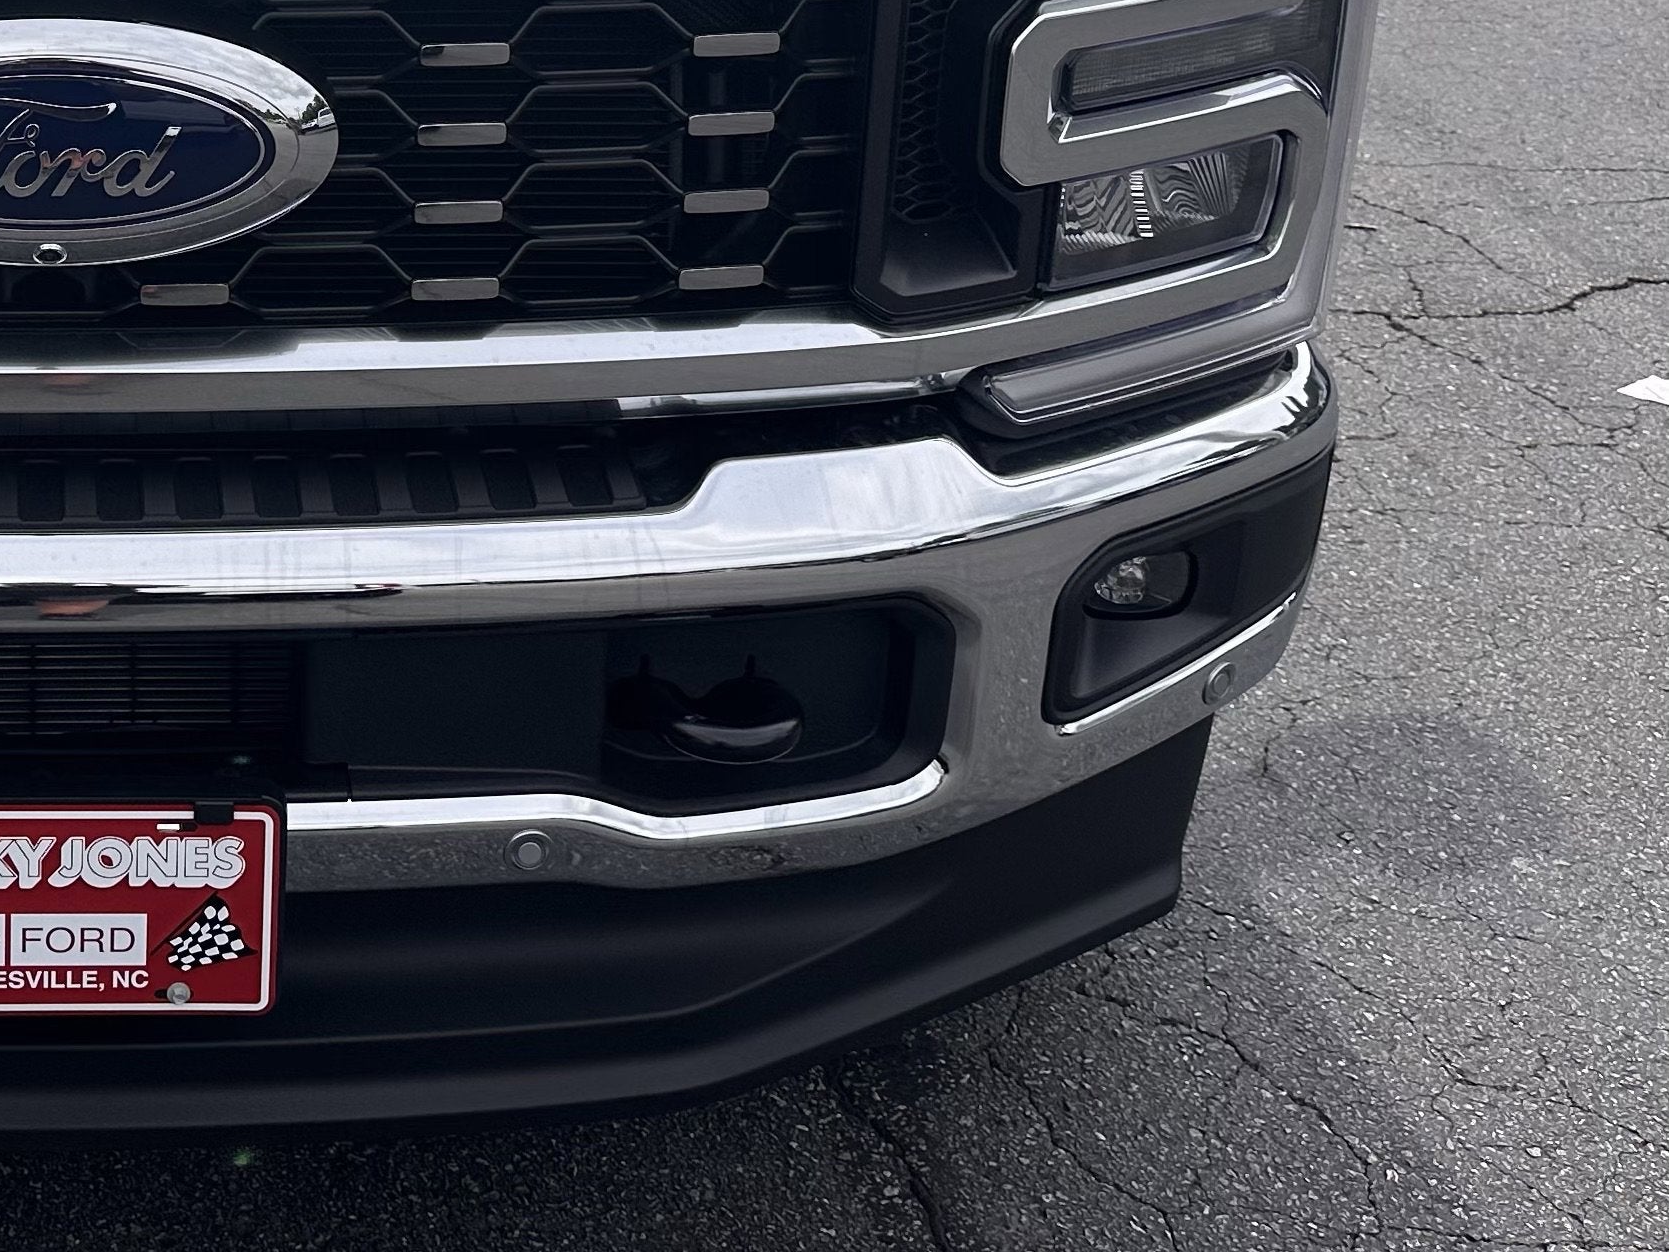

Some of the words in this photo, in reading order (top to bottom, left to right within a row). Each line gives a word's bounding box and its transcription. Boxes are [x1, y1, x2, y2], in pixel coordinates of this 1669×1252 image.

[48, 836, 246, 889] JONES
[21, 927, 136, 953] FORD
[113, 969, 149, 989] NC
